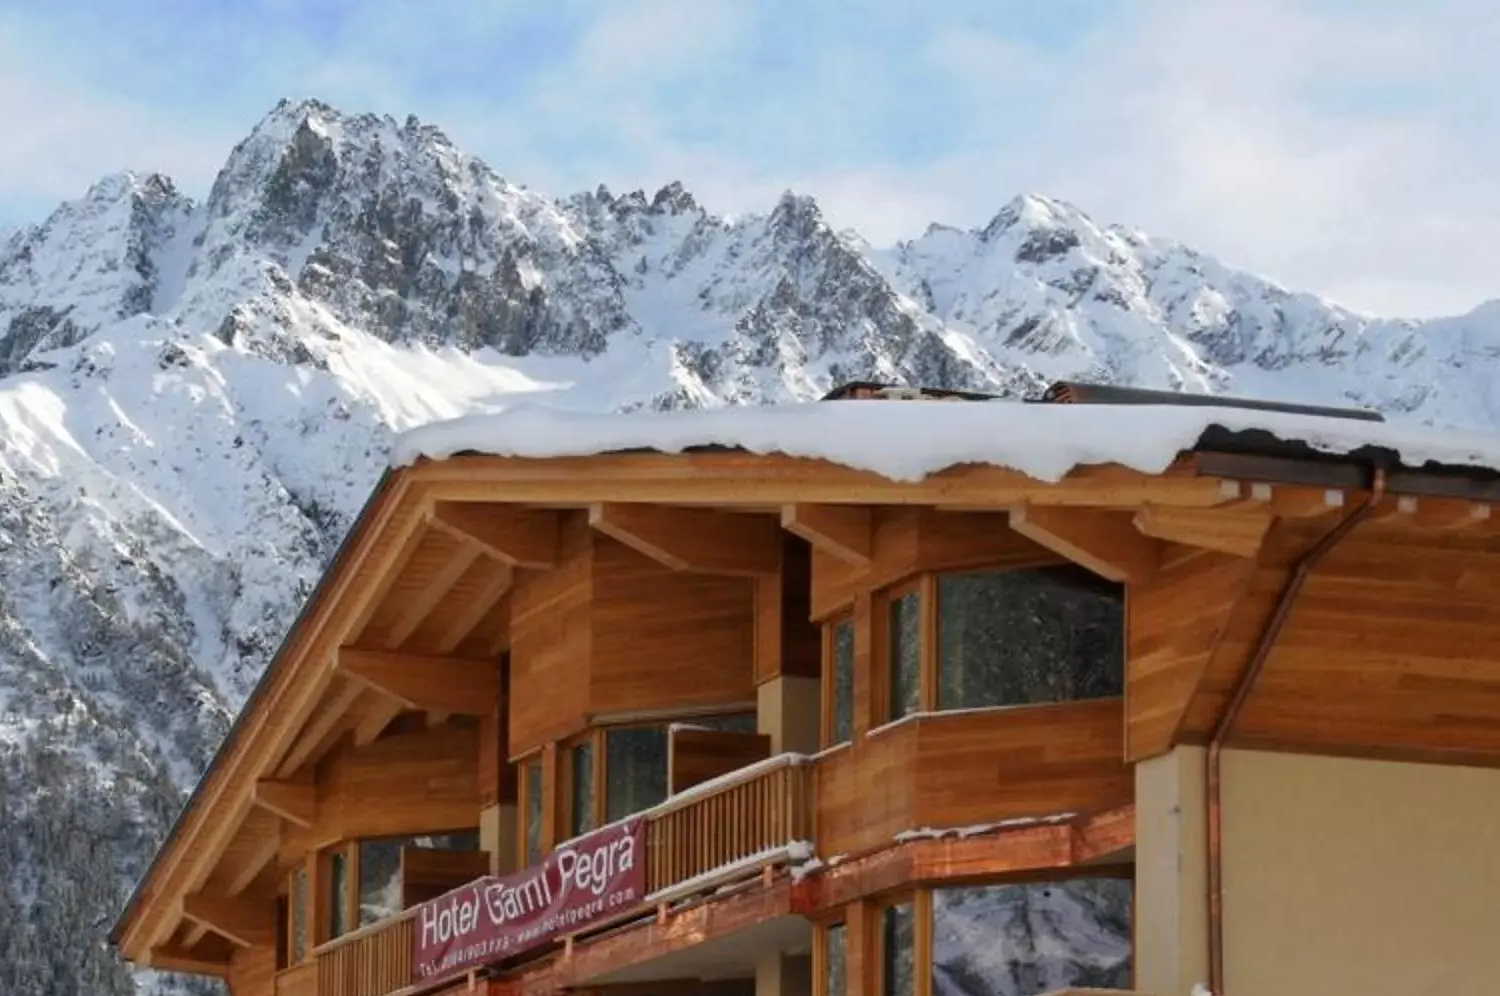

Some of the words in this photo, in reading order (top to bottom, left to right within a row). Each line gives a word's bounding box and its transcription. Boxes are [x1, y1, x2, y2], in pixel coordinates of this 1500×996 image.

[421, 889, 480, 950] Hotel
[484, 863, 551, 925] Garni
[558, 826, 635, 897] Pegrà
